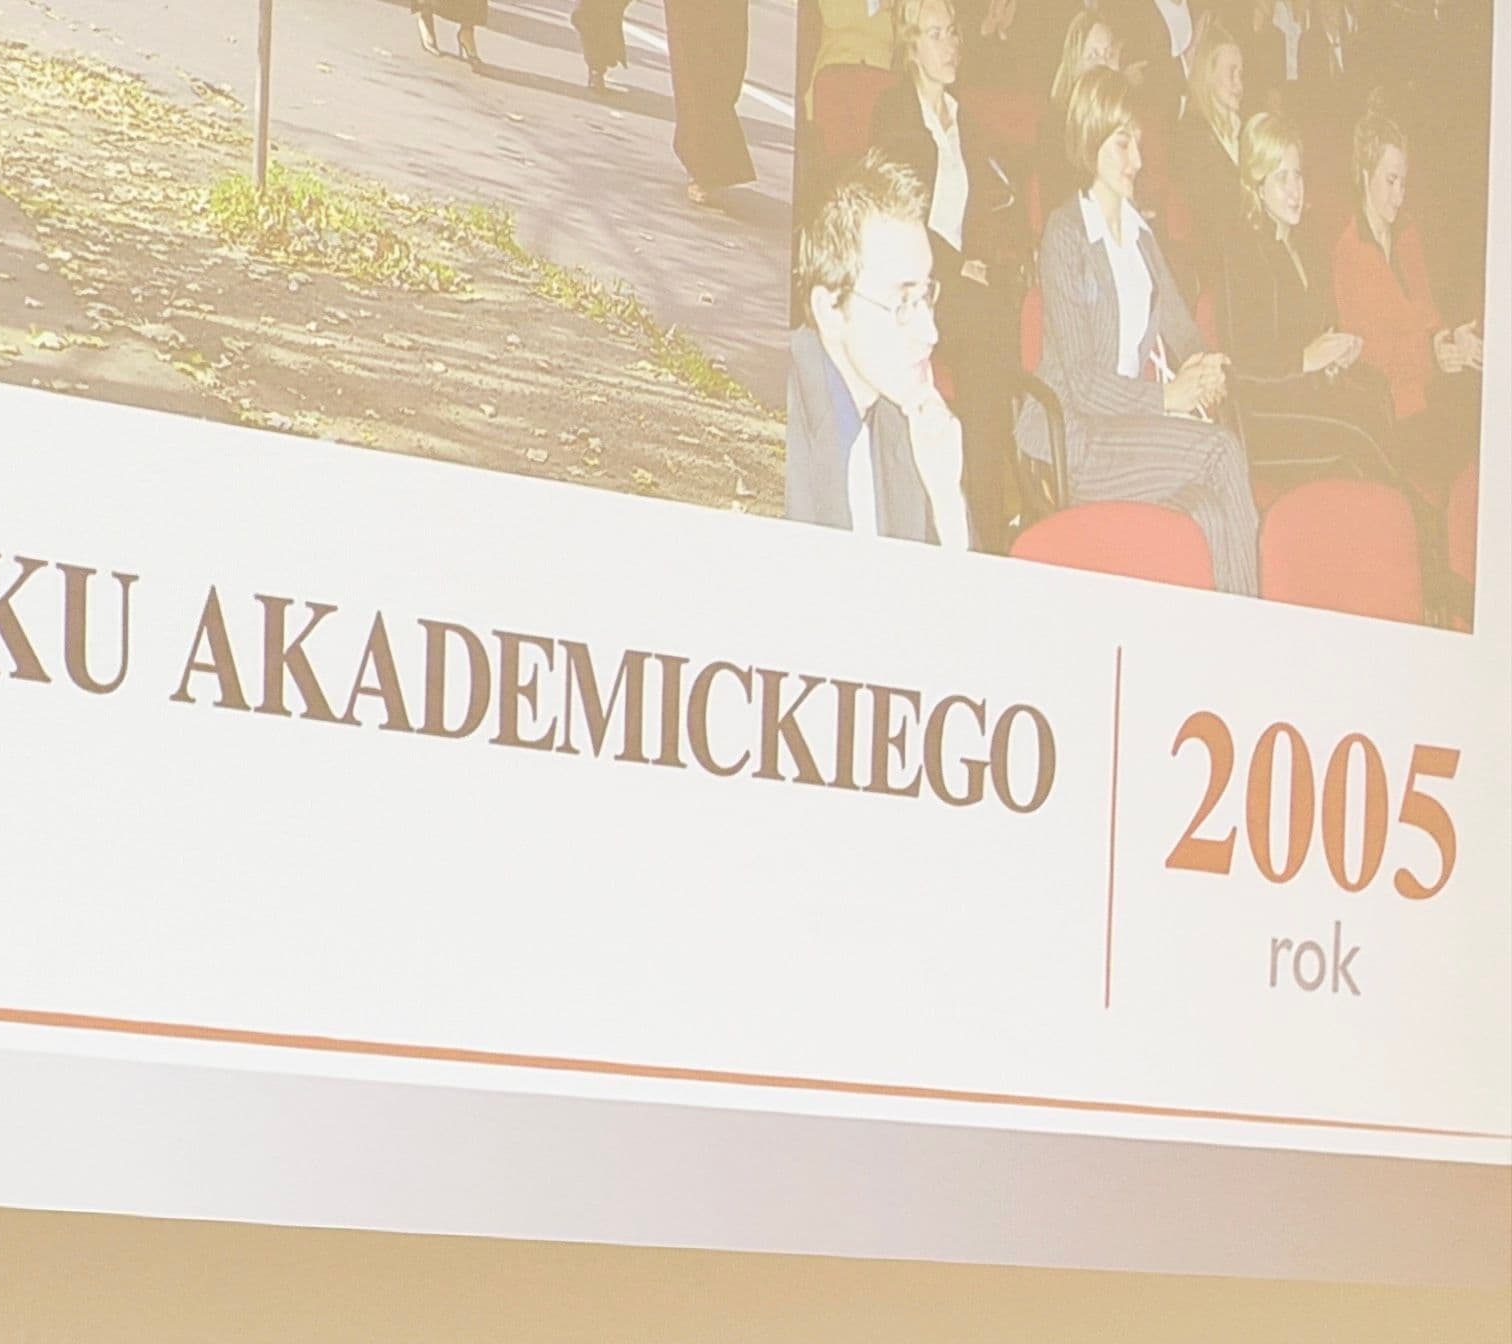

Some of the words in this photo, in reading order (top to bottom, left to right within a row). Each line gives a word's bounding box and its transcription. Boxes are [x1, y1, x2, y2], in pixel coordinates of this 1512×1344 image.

[169, 585, 1058, 815] AKADEMICKIEGO
[1164, 710, 1462, 901] 2005
[1269, 920, 1362, 997] rok
